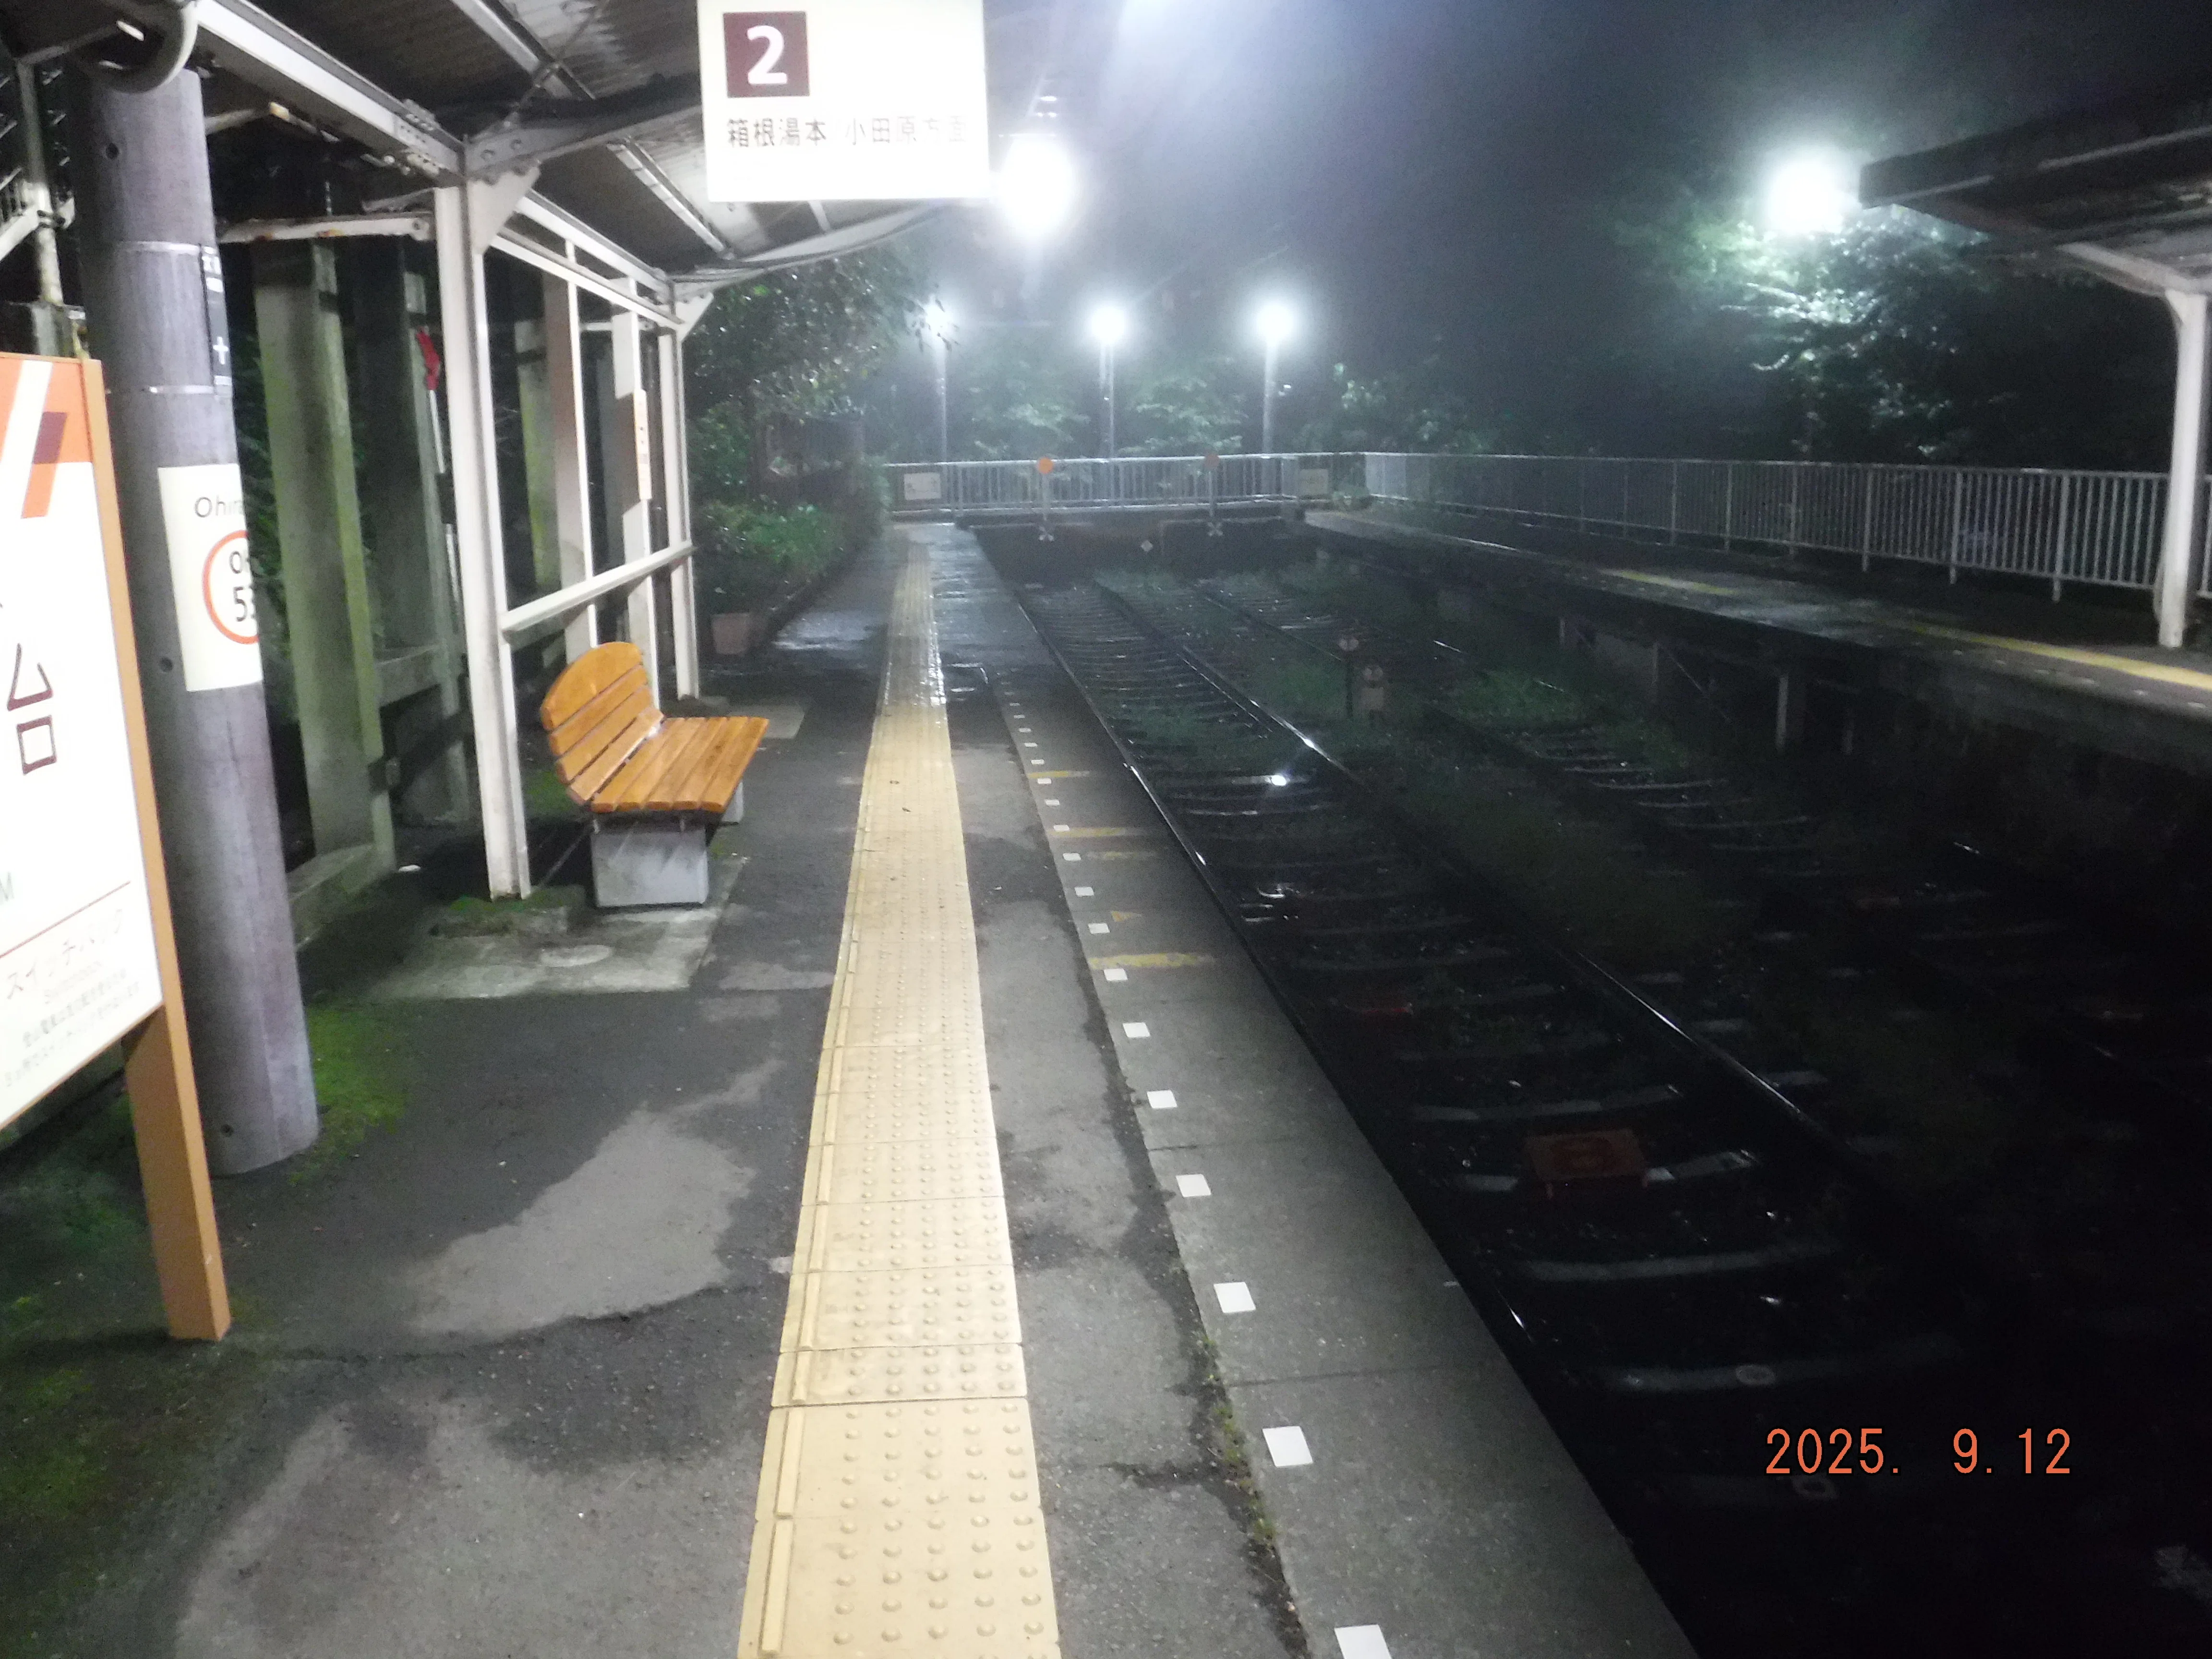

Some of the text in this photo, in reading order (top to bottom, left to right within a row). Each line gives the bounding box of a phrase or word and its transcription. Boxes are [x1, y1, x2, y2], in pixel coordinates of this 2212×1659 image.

[746, 24, 788, 84] 2
[726, 117, 828, 148] 箱根湯本
